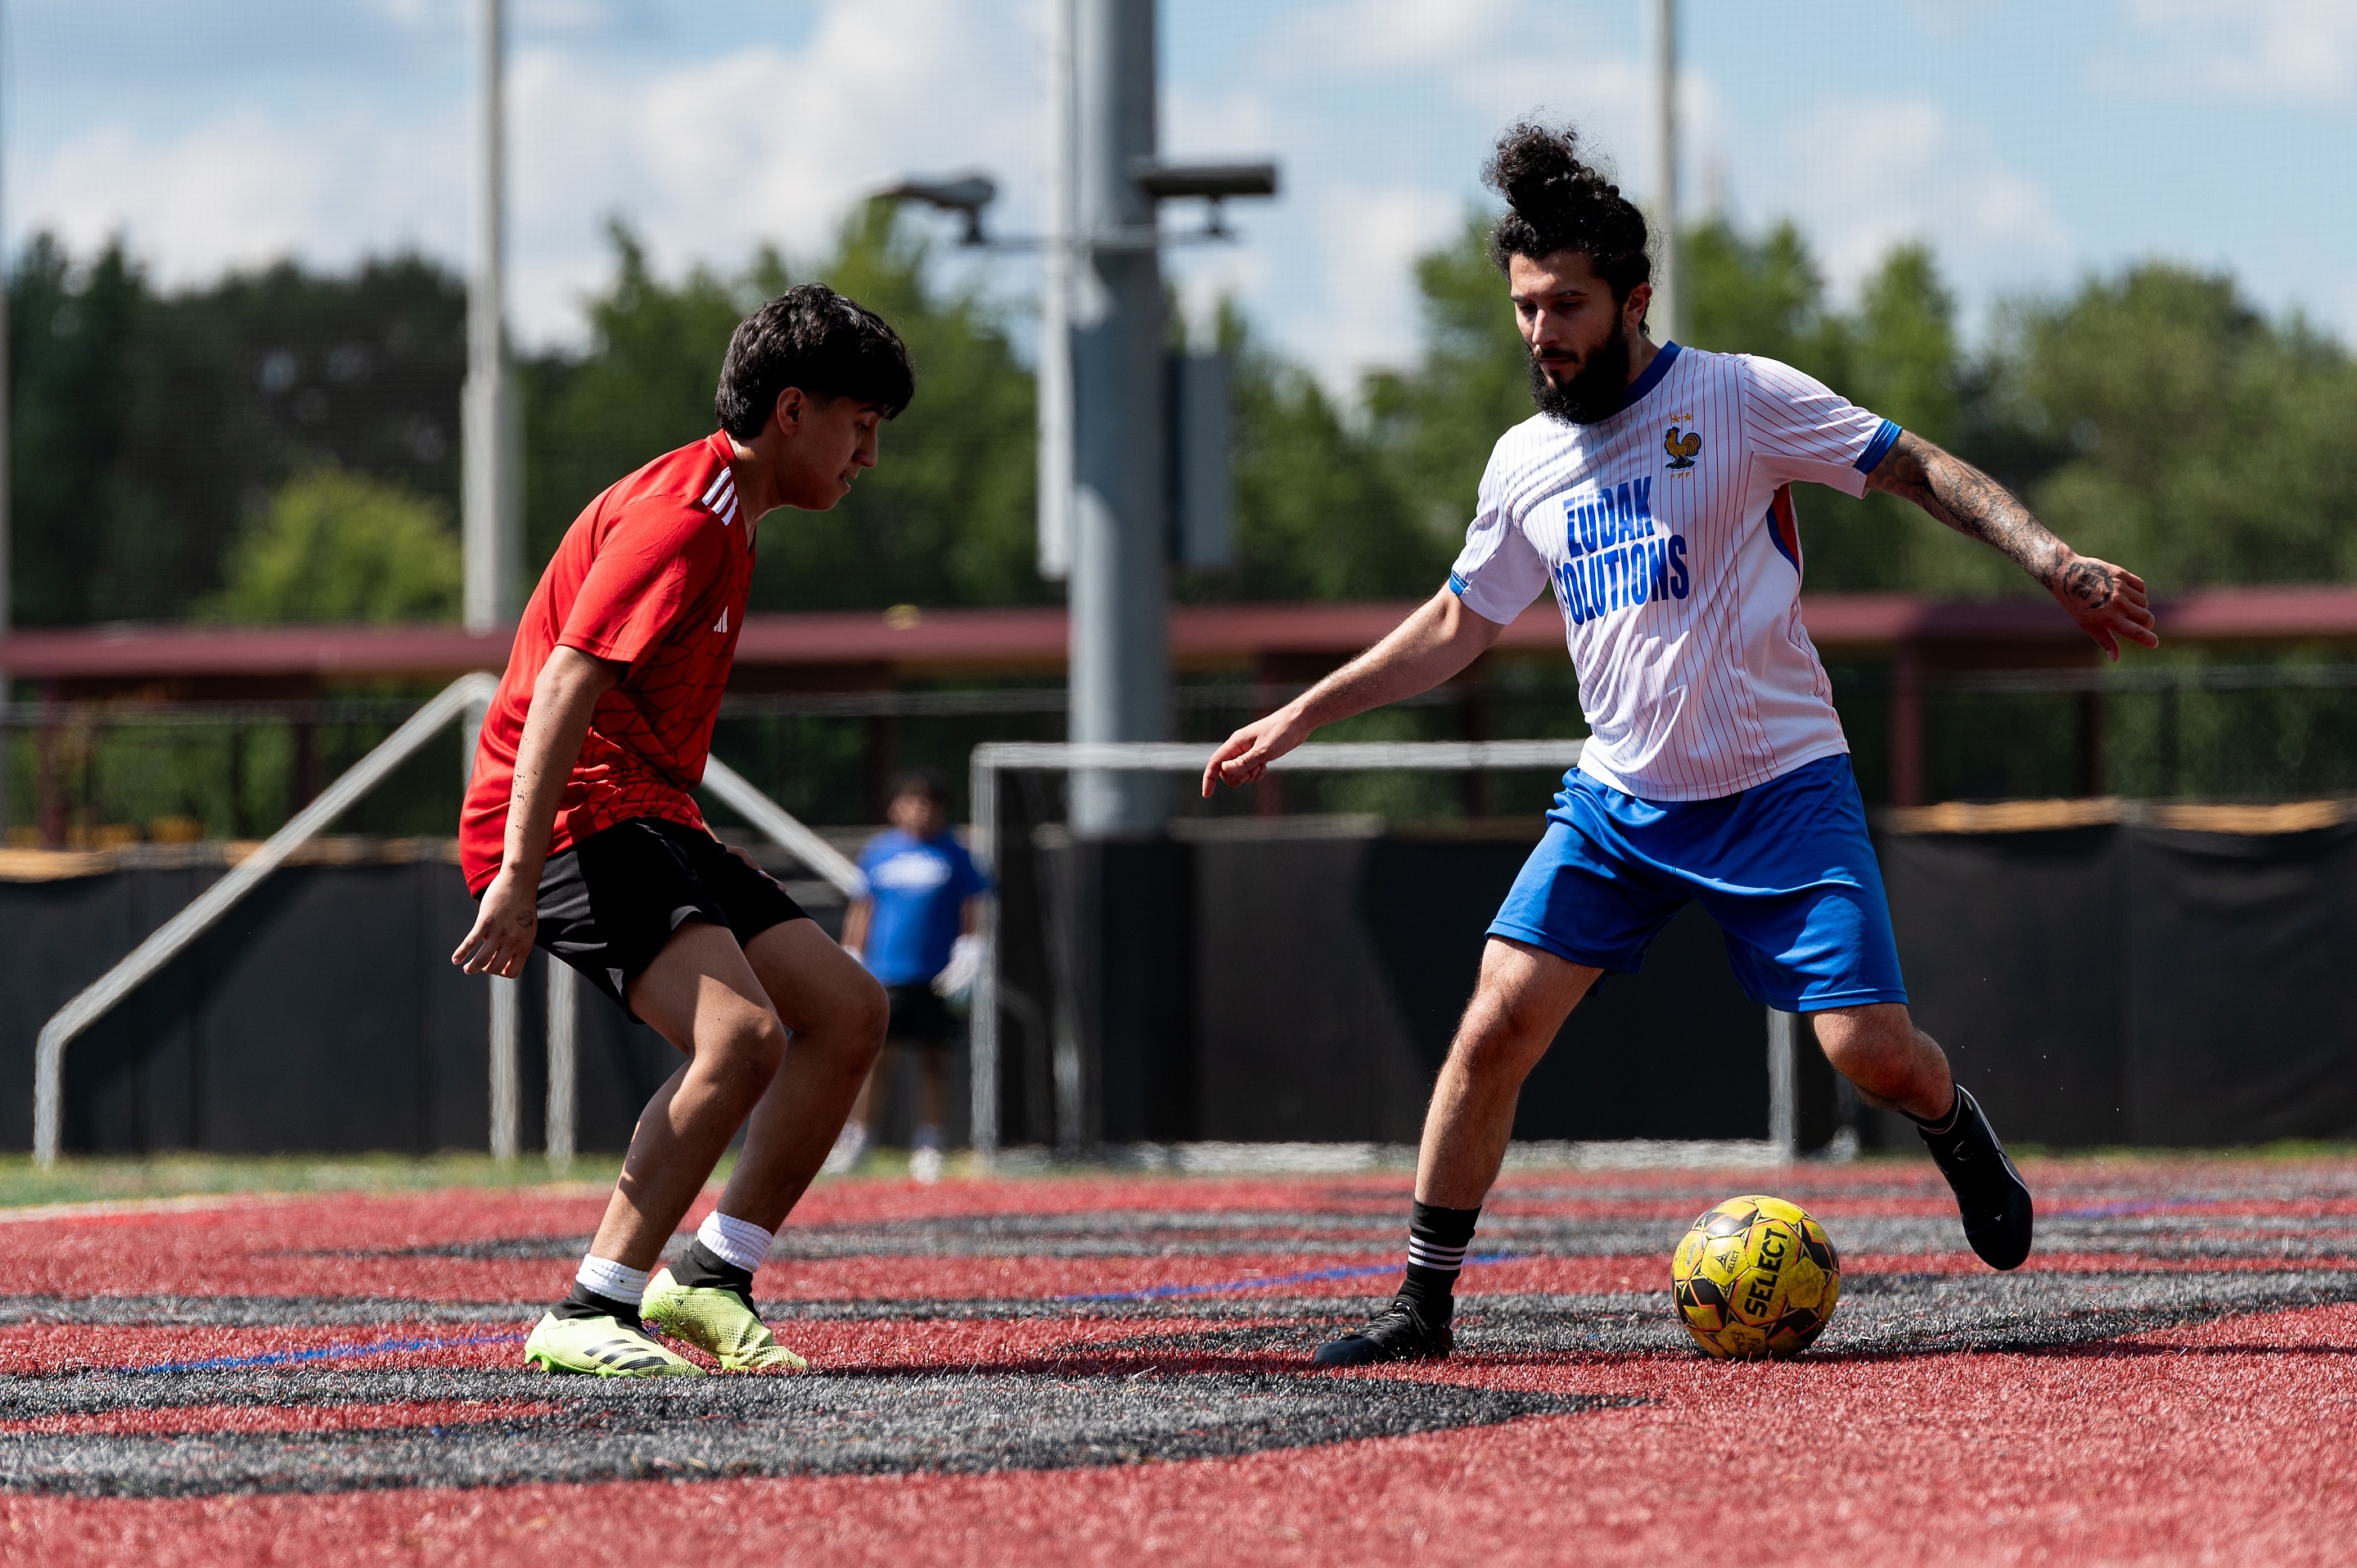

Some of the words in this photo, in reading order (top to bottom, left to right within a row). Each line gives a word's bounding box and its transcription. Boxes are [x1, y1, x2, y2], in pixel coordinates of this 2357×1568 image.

[1563, 475, 1656, 558] ZUDAK
[1727, 1250, 1740, 1274] SELECT
[1743, 1228, 1788, 1318] SELECT
